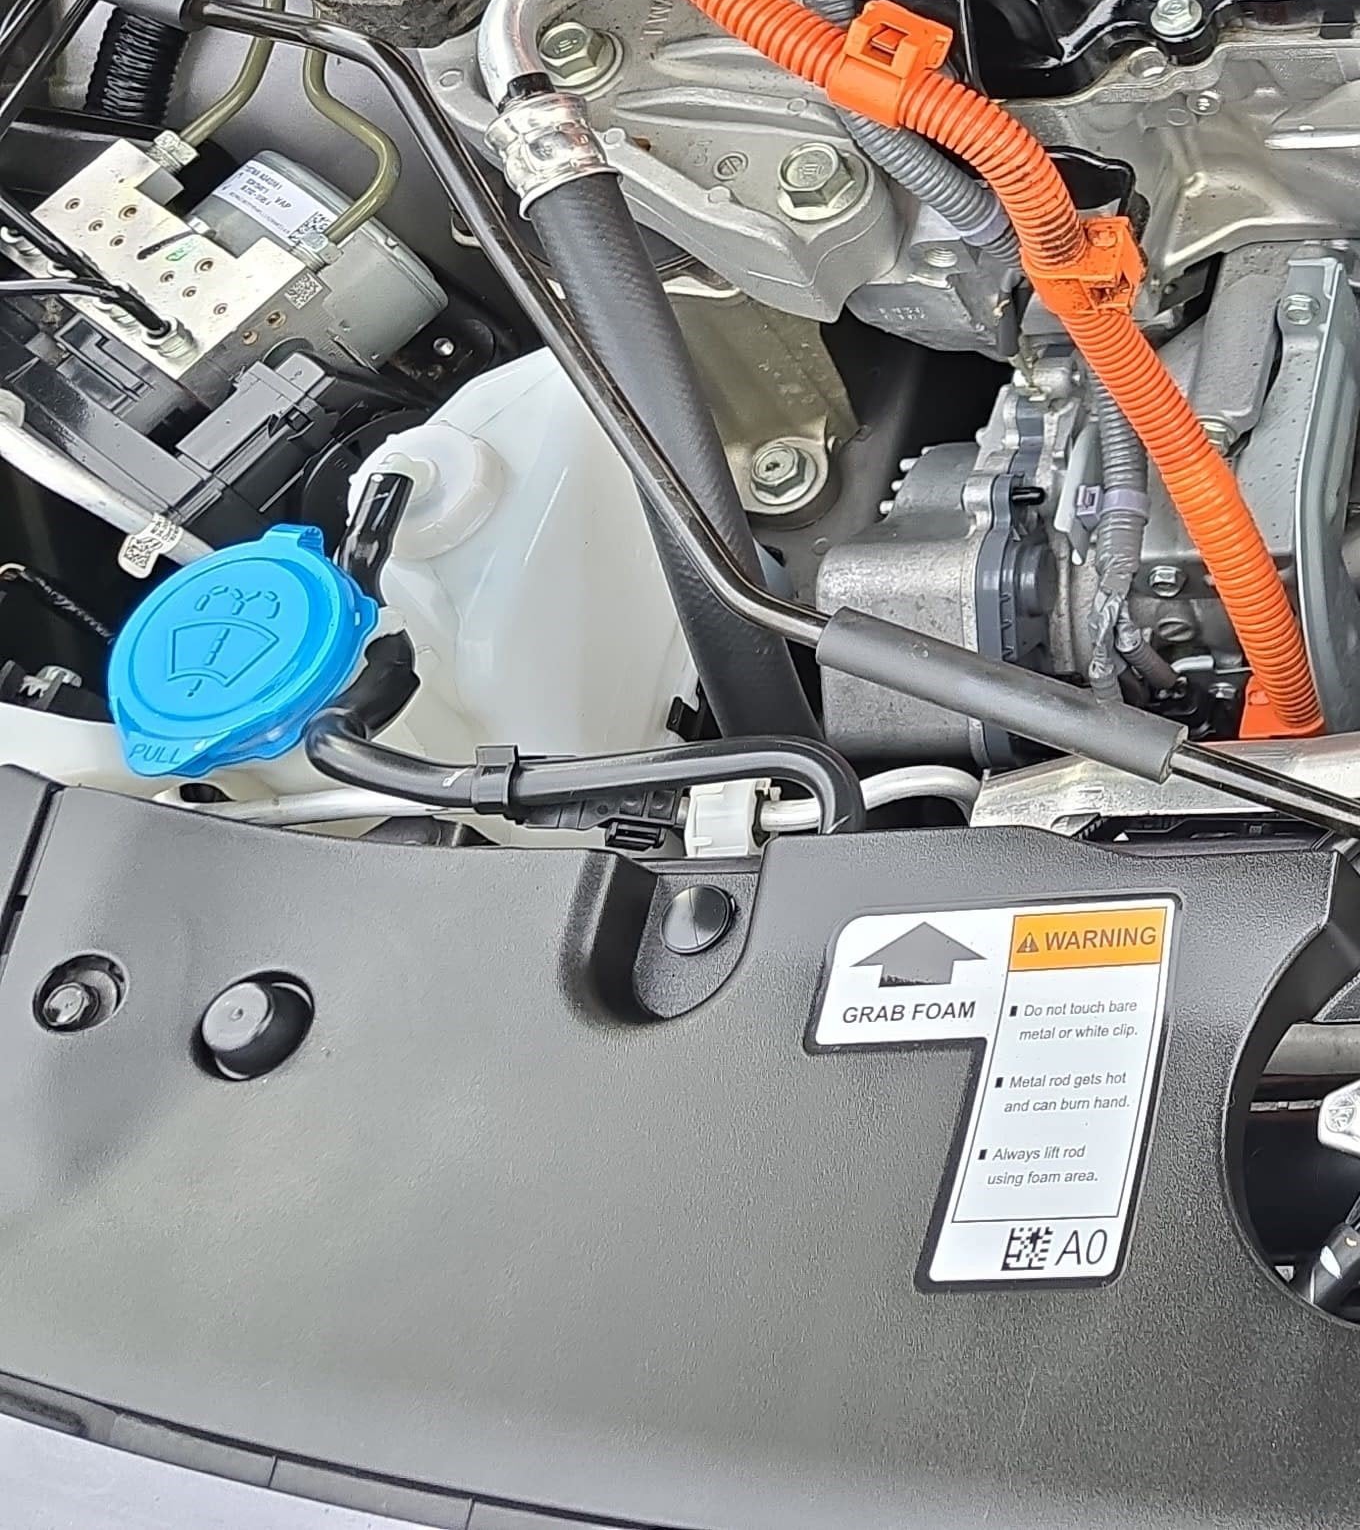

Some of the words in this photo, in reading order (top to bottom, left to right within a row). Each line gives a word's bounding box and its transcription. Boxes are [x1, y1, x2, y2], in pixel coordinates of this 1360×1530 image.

[128, 743, 180, 764] PULL
[1045, 926, 1157, 951] WARNING
[842, 1004, 905, 1023] GRAB
[912, 1001, 976, 1020] FOAM
[1024, 1004, 1043, 1017] Do
[1046, 1003, 1067, 1016] not
[1069, 1001, 1105, 1015] touch
[1108, 1000, 1138, 1014] bare
[1019, 1026, 1056, 1041] metal
[1058, 1028, 1073, 1039] or
[1074, 1024, 1109, 1038] white
[1112, 1023, 1139, 1041] clip.
[1009, 1074, 1047, 1089] Metal
[1048, 1074, 1071, 1088] rod
[1074, 1074, 1103, 1090] gets
[1104, 1072, 1127, 1086] hot
[1004, 1099, 1030, 1113] and
[1032, 1100, 1057, 1113] can
[1059, 1097, 1090, 1111] burn
[1093, 1095, 1131, 1110] hand.
[992, 1146, 1041, 1162] Always
[1043, 1146, 1061, 1160] lift
[1063, 1145, 1086, 1159] rod
[987, 1171, 1023, 1187] using
[1026, 1170, 1061, 1184] foam
[1064, 1170, 1099, 1183] area.
[1055, 1228, 1108, 1266] A0
